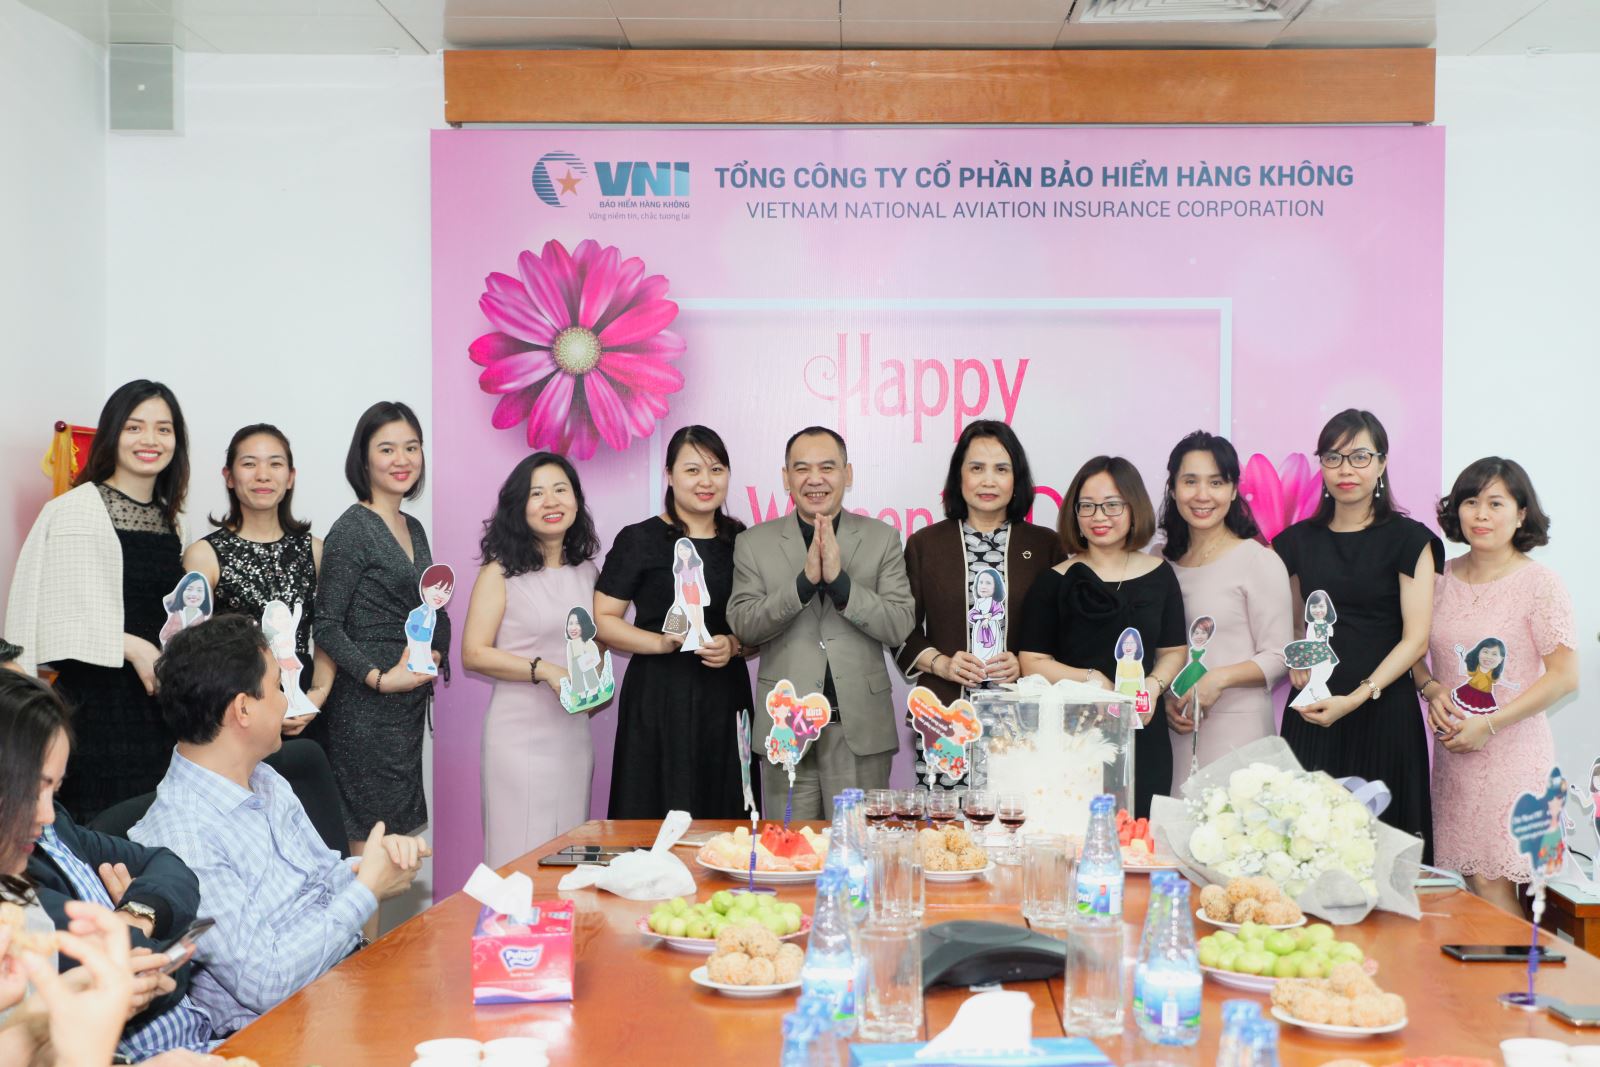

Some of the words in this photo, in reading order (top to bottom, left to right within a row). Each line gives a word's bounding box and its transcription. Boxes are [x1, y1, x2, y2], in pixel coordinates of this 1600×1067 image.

[594, 161, 690, 197] VNI
[713, 159, 786, 189] TỔNG
[793, 161, 867, 189] CÔNG
[875, 167, 908, 189] TY
[915, 159, 952, 189] CỔ
[958, 159, 1033, 189] PHẦN
[1040, 159, 1094, 188] BẢO
[1101, 158, 1169, 188] HIỂM
[1176, 160, 1252, 188] HÀNG
[1259, 159, 1354, 187] KHÔNG
[746, 201, 838, 219] VIETNAM
[845, 201, 947, 219] NATIONAL
[952, 200, 1046, 218] AVIATION
[1053, 200, 1171, 218] INSURANCE
[1177, 199, 1324, 218] CORPORATION
[803, 332, 1030, 443] Happy
